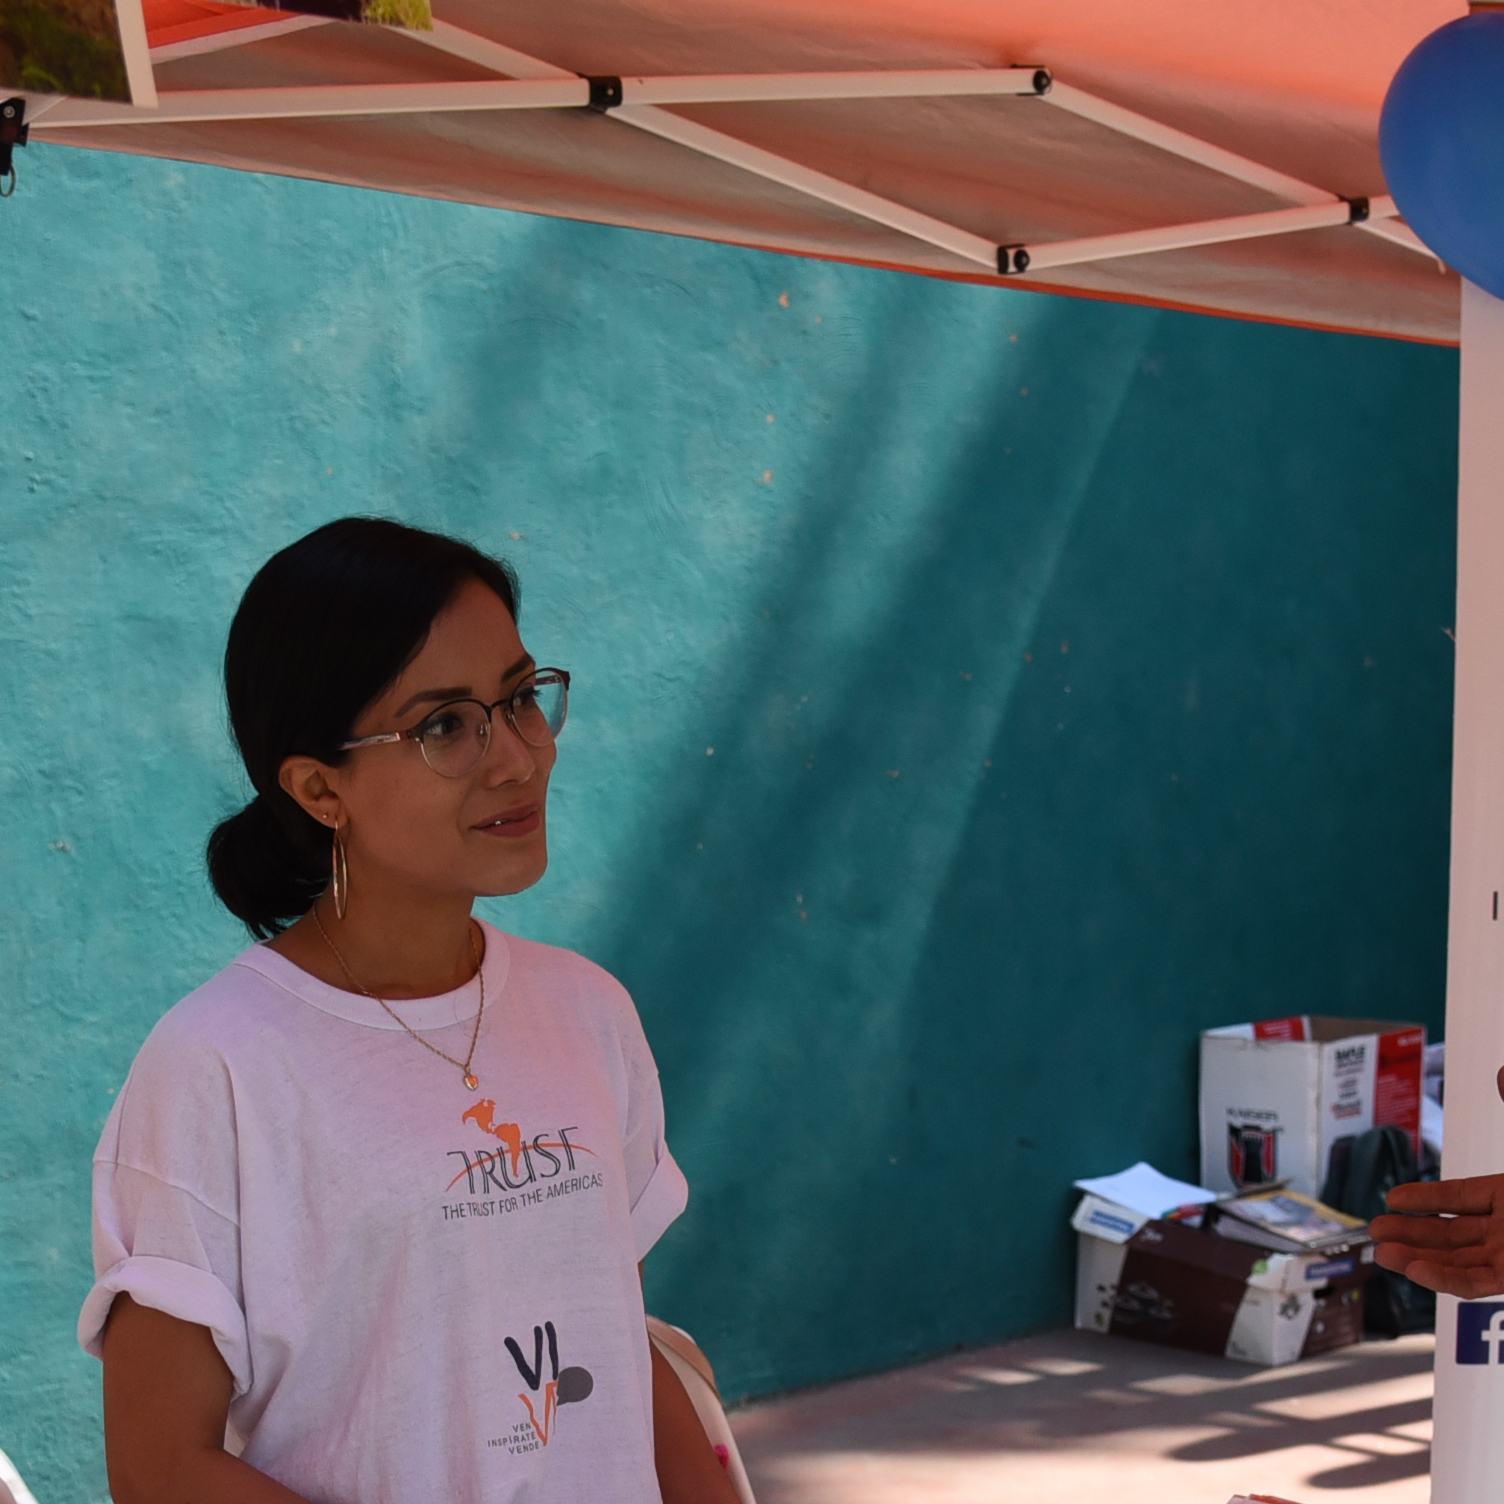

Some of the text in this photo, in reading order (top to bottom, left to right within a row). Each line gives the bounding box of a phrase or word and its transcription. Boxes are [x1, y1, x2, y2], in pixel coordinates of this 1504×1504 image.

[447, 1126, 578, 1194] TRUST
[442, 1173, 603, 1220] THE TRUST FOR THE AMERICAS
[504, 1321, 558, 1391] VI
[487, 1431, 536, 1447] INSPÍRATE
[512, 1422, 531, 1432] VEN
[508, 1441, 539, 1454] VENDE
